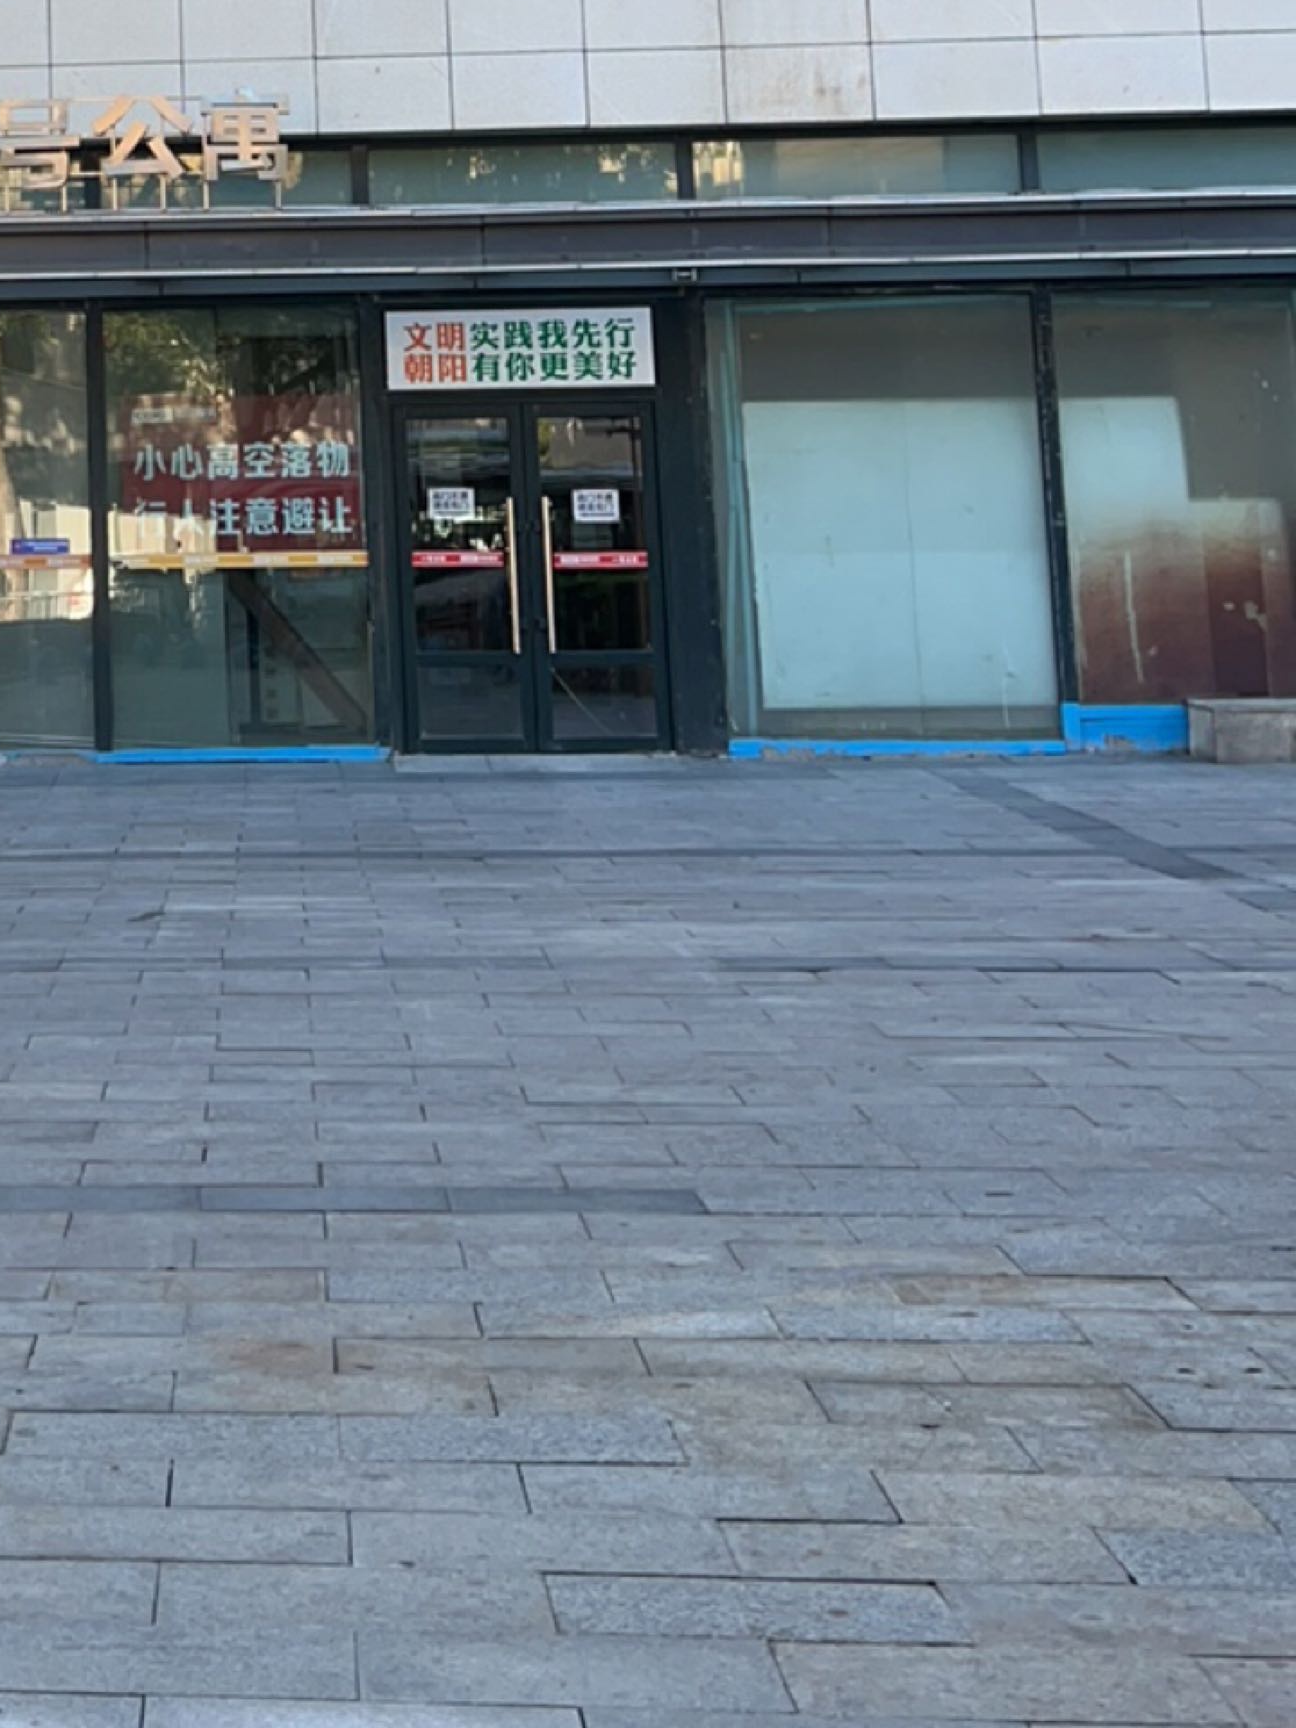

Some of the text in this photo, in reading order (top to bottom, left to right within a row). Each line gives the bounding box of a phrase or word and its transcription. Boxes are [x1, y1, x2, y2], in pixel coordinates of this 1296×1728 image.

[404, 317, 636, 352] 文明实践我先行
[405, 351, 637, 384] 朝阳有你更美好
[134, 440, 350, 481] 小心高空落物
[134, 497, 353, 536] 行人注意避让
